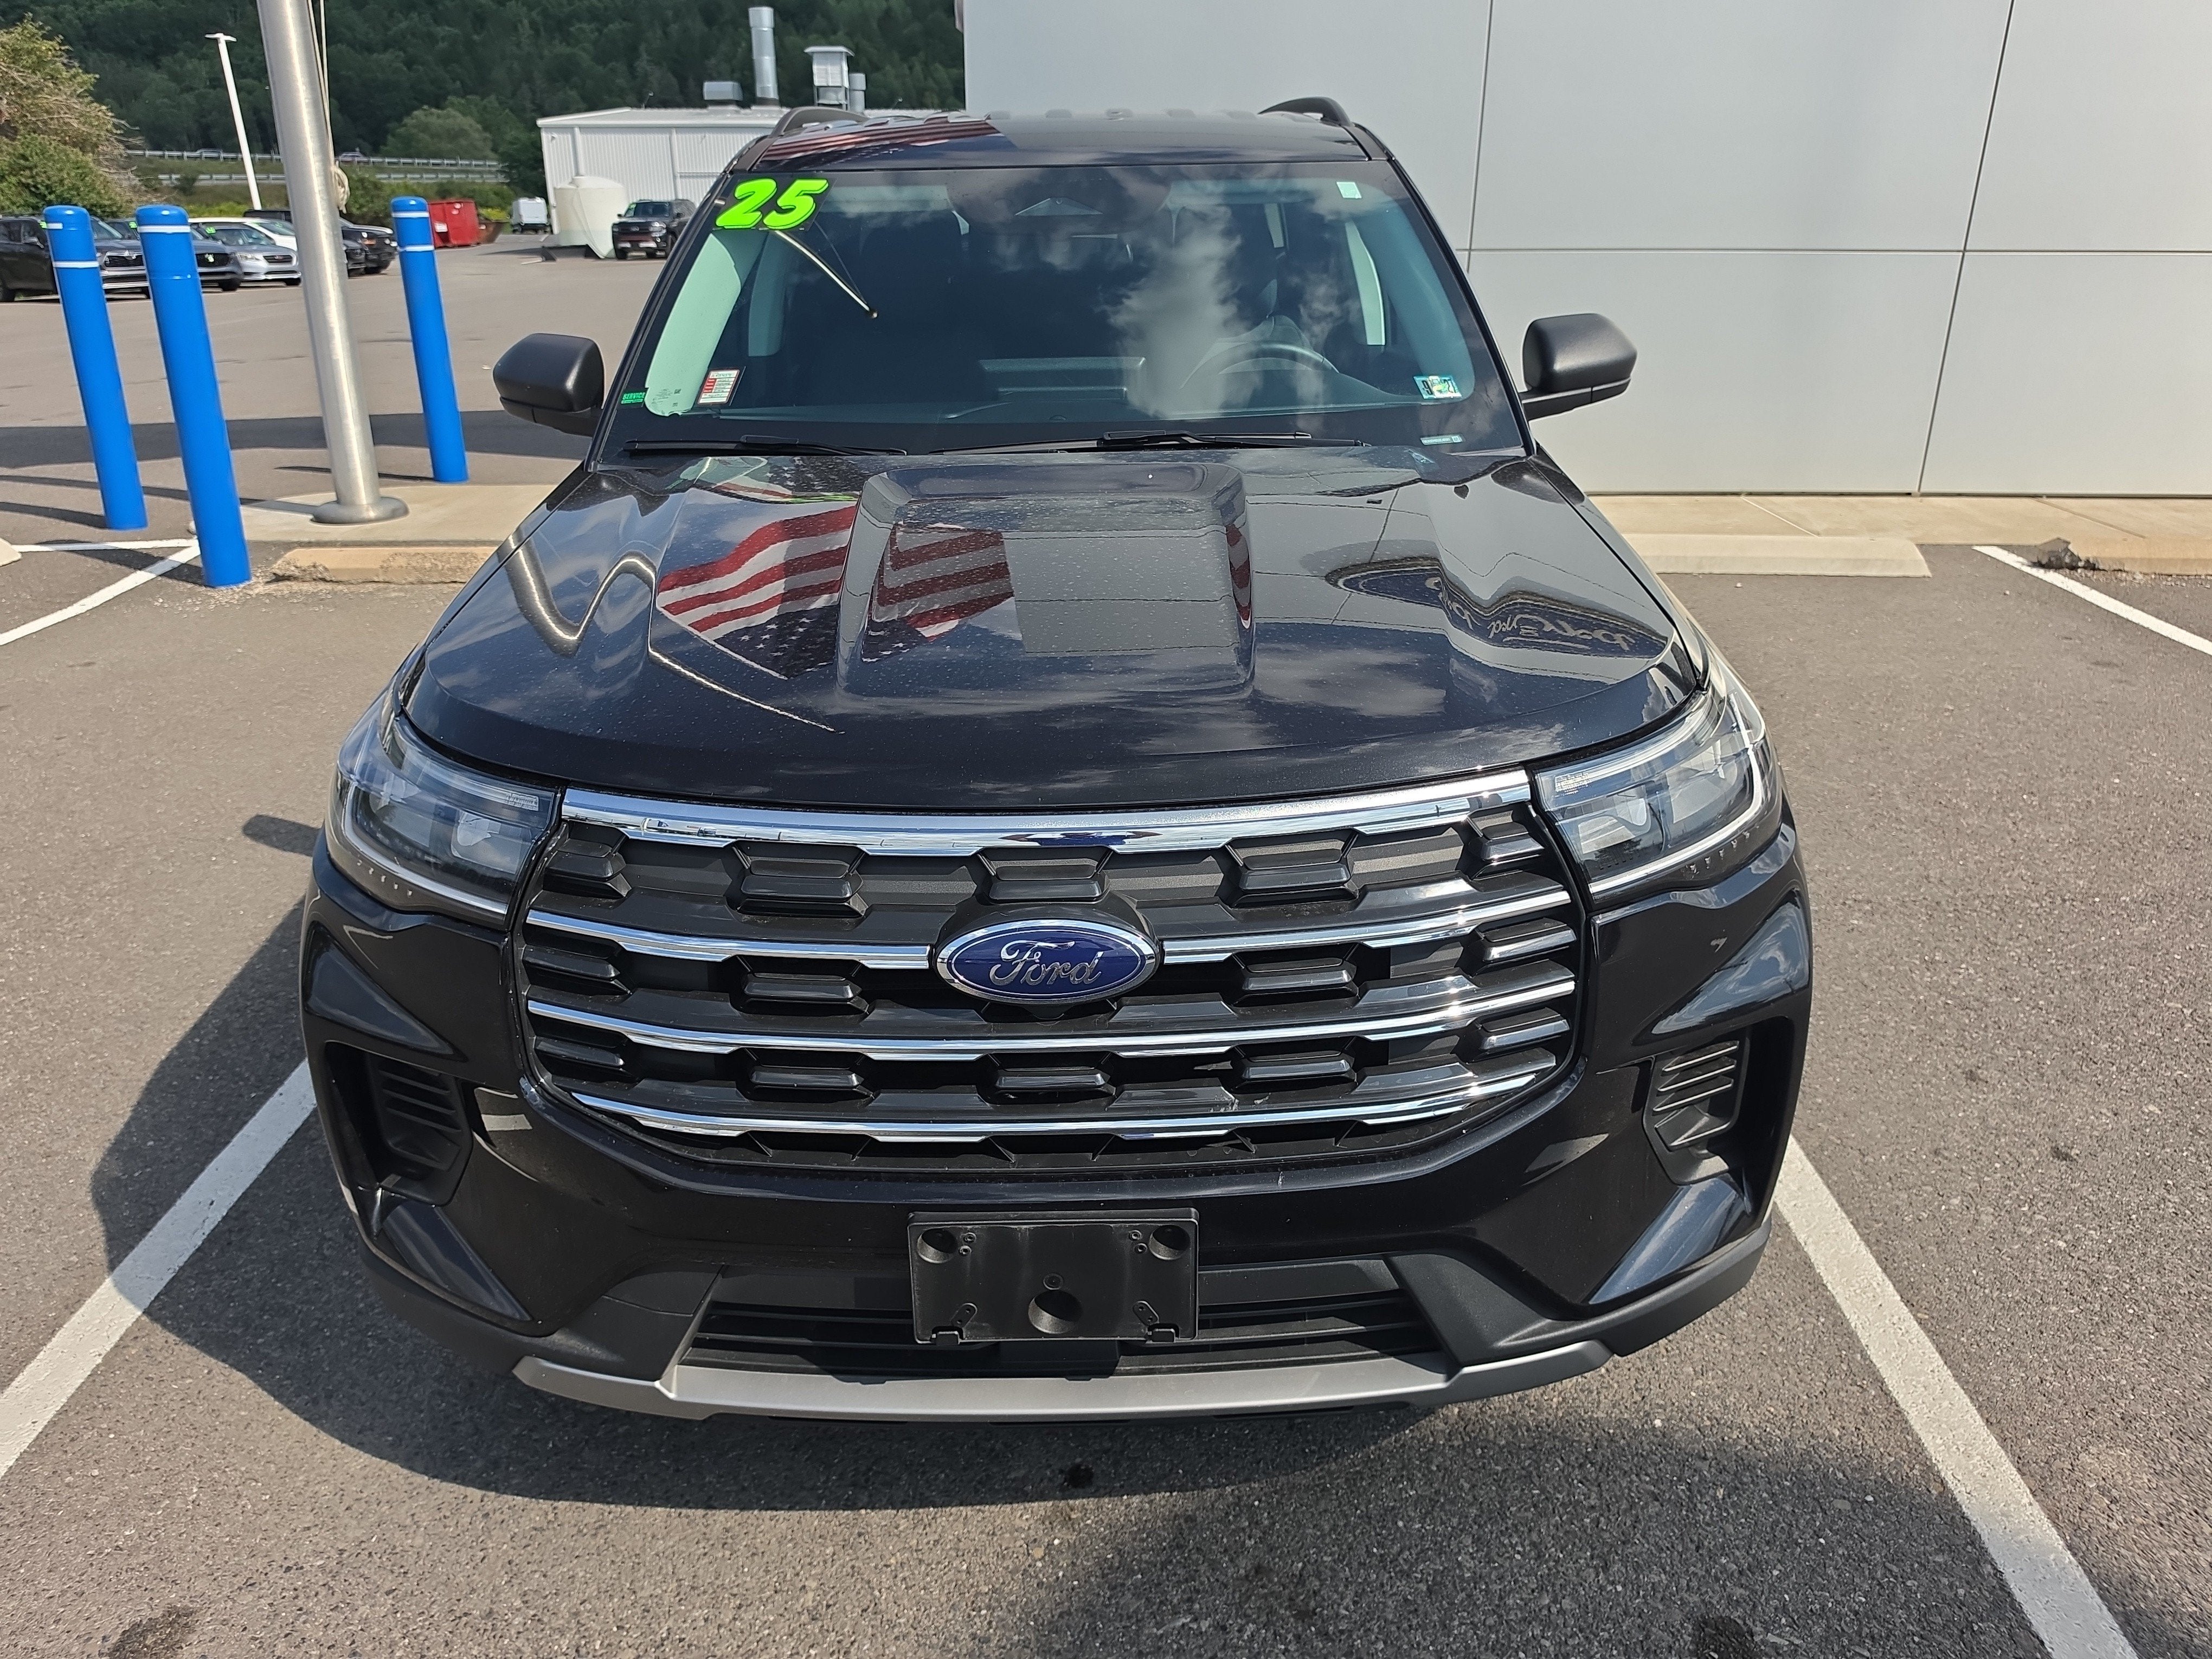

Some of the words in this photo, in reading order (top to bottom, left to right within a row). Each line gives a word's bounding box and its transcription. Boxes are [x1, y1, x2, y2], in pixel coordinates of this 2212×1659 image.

[716, 178, 829, 229] 25
[1421, 380, 1433, 395] 9
[988, 939, 1105, 987] Ford
